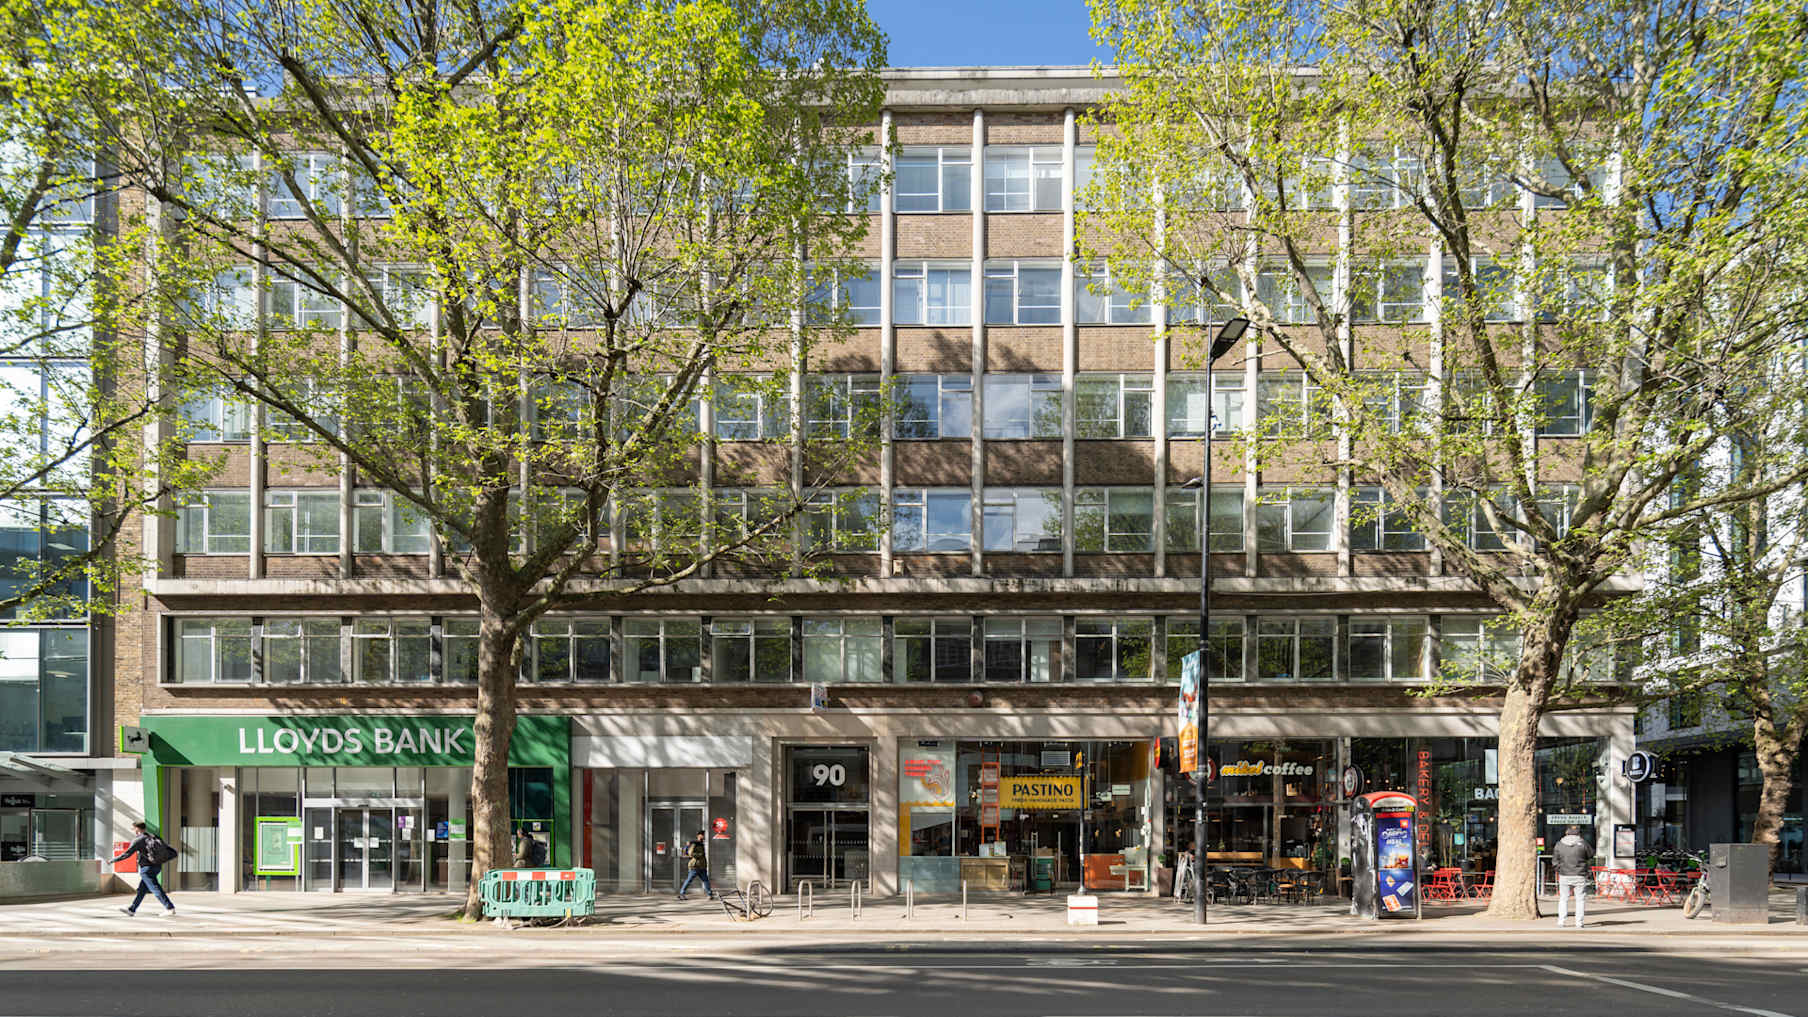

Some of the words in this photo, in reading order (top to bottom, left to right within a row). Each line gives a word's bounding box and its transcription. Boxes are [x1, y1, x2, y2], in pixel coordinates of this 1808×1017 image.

[239, 728, 363, 754] LLOYDS
[374, 728, 467, 754] BANK
[813, 764, 846, 786] 90
[1263, 762, 1313, 775] coffee
[1417, 751, 1431, 805] BAKERY
[1012, 783, 1073, 796] PASTINO
[1418, 811, 1429, 820] &
[1417, 823, 1430, 852] DEL
